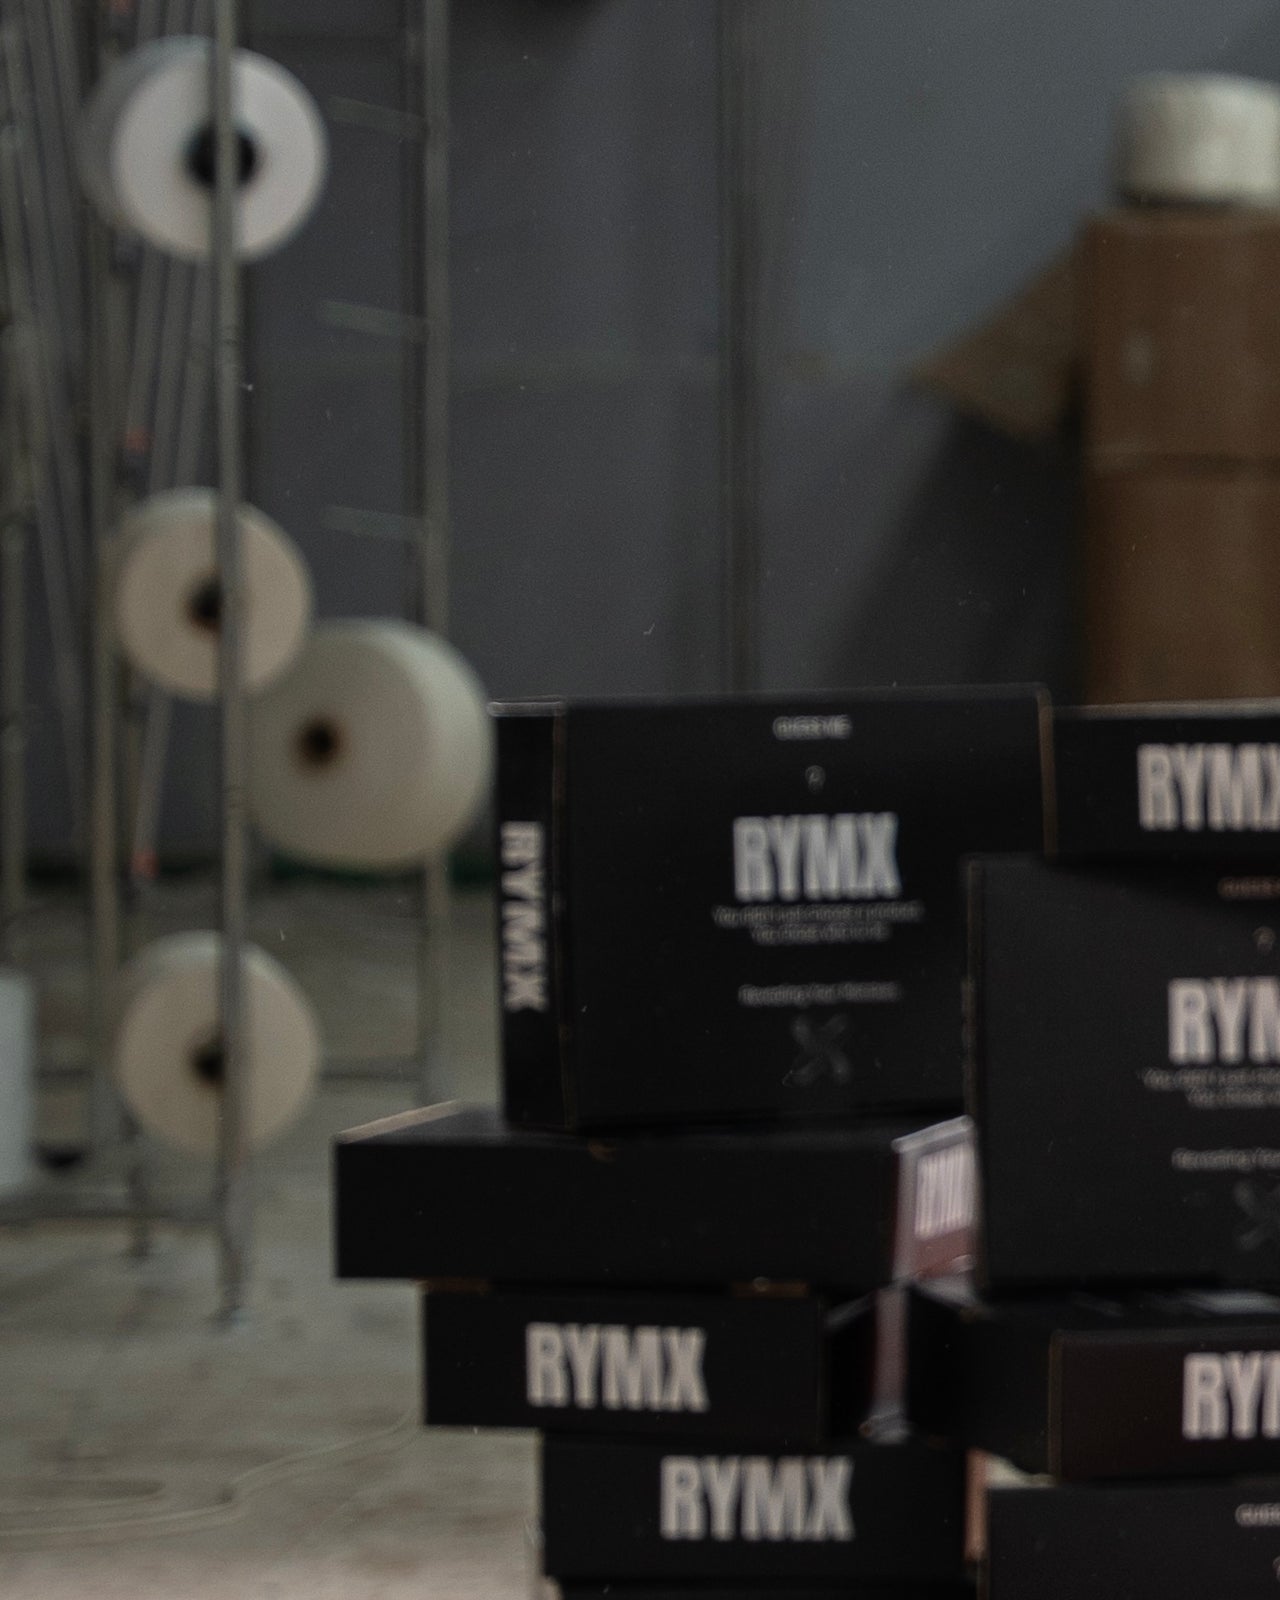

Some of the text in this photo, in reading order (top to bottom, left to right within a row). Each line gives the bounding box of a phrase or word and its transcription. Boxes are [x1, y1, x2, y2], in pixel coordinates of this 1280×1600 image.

[733, 812, 900, 901] RYMX
[502, 821, 547, 1012] RYMX
[526, 1322, 708, 1412] RYMX
[660, 1456, 853, 1541] RYMX
